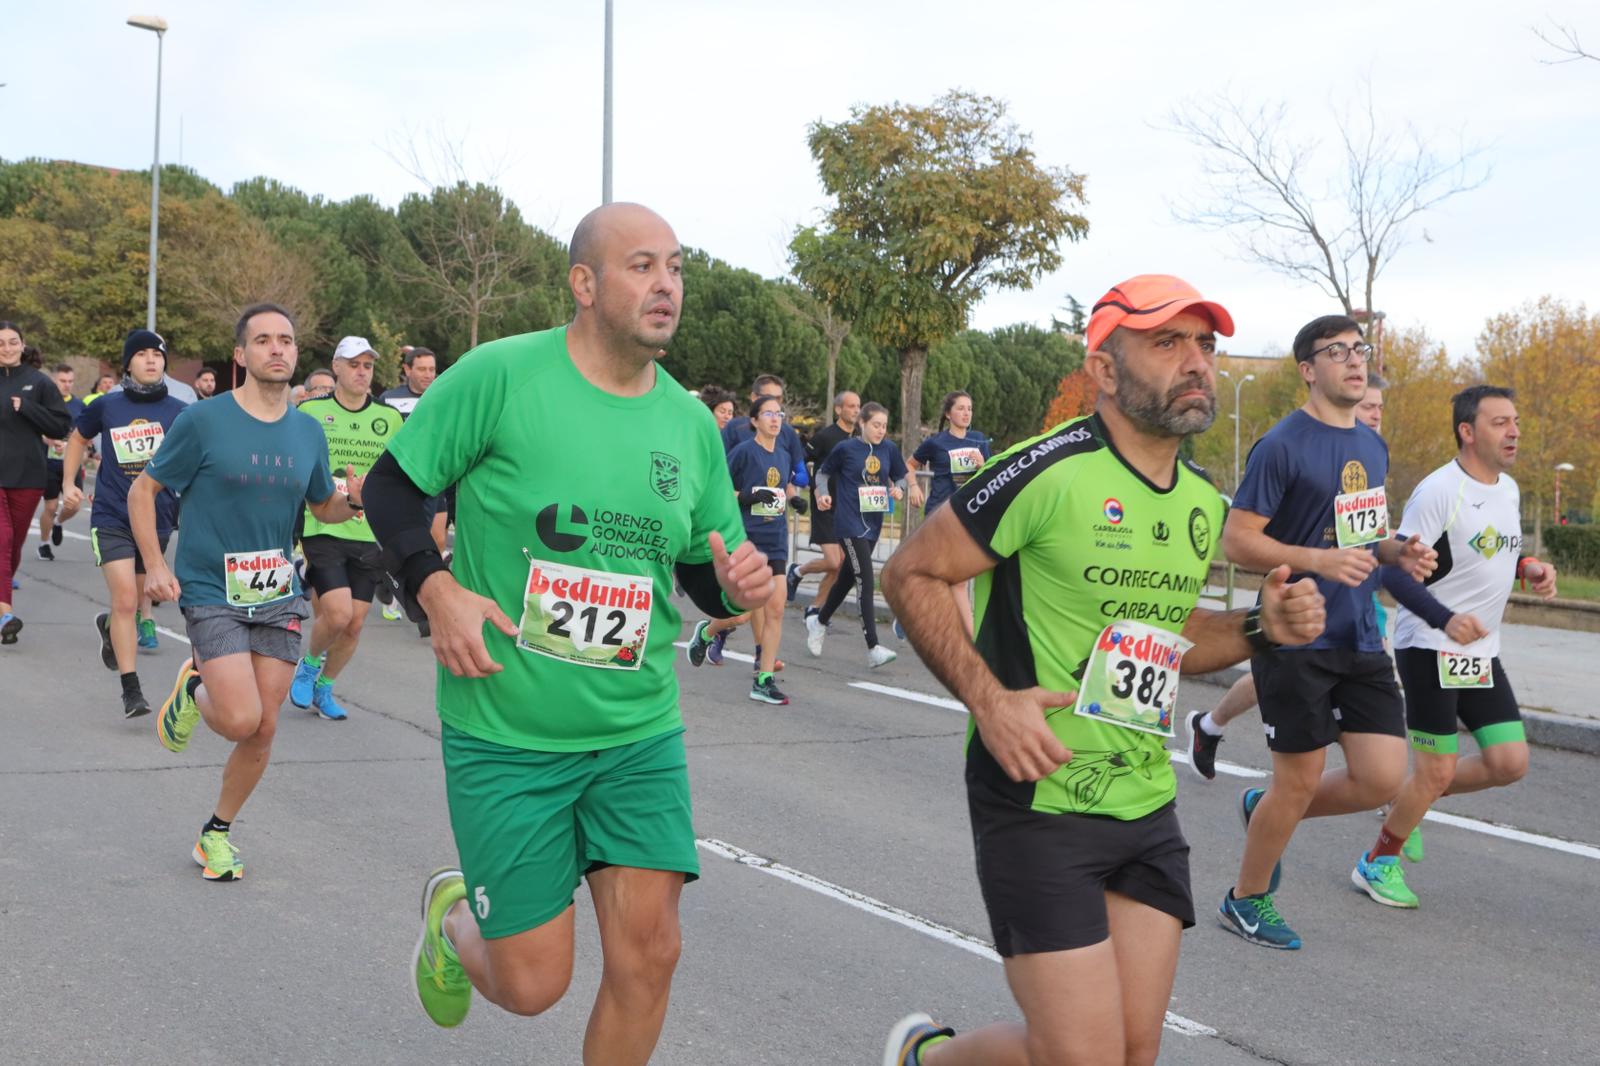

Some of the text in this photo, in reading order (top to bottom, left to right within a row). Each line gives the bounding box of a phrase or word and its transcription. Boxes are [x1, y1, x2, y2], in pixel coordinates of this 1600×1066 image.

[125, 436, 155, 454] 137
[252, 454, 294, 468] NIKE
[967, 427, 1092, 514] CORRECAMINOS
[867, 495, 885, 505] 198
[1336, 492, 1386, 516] bedunia
[593, 508, 663, 533] LORENZO
[1347, 509, 1377, 533] 173
[591, 525, 669, 550] GONZÁLEZ
[249, 569, 278, 591] 44
[528, 567, 651, 611] bedunia
[546, 600, 627, 646] 212
[1097, 624, 1182, 673] bedunia
[1448, 657, 1481, 676] 225
[1111, 660, 1167, 709] 382
[475, 885, 490, 920] 5
